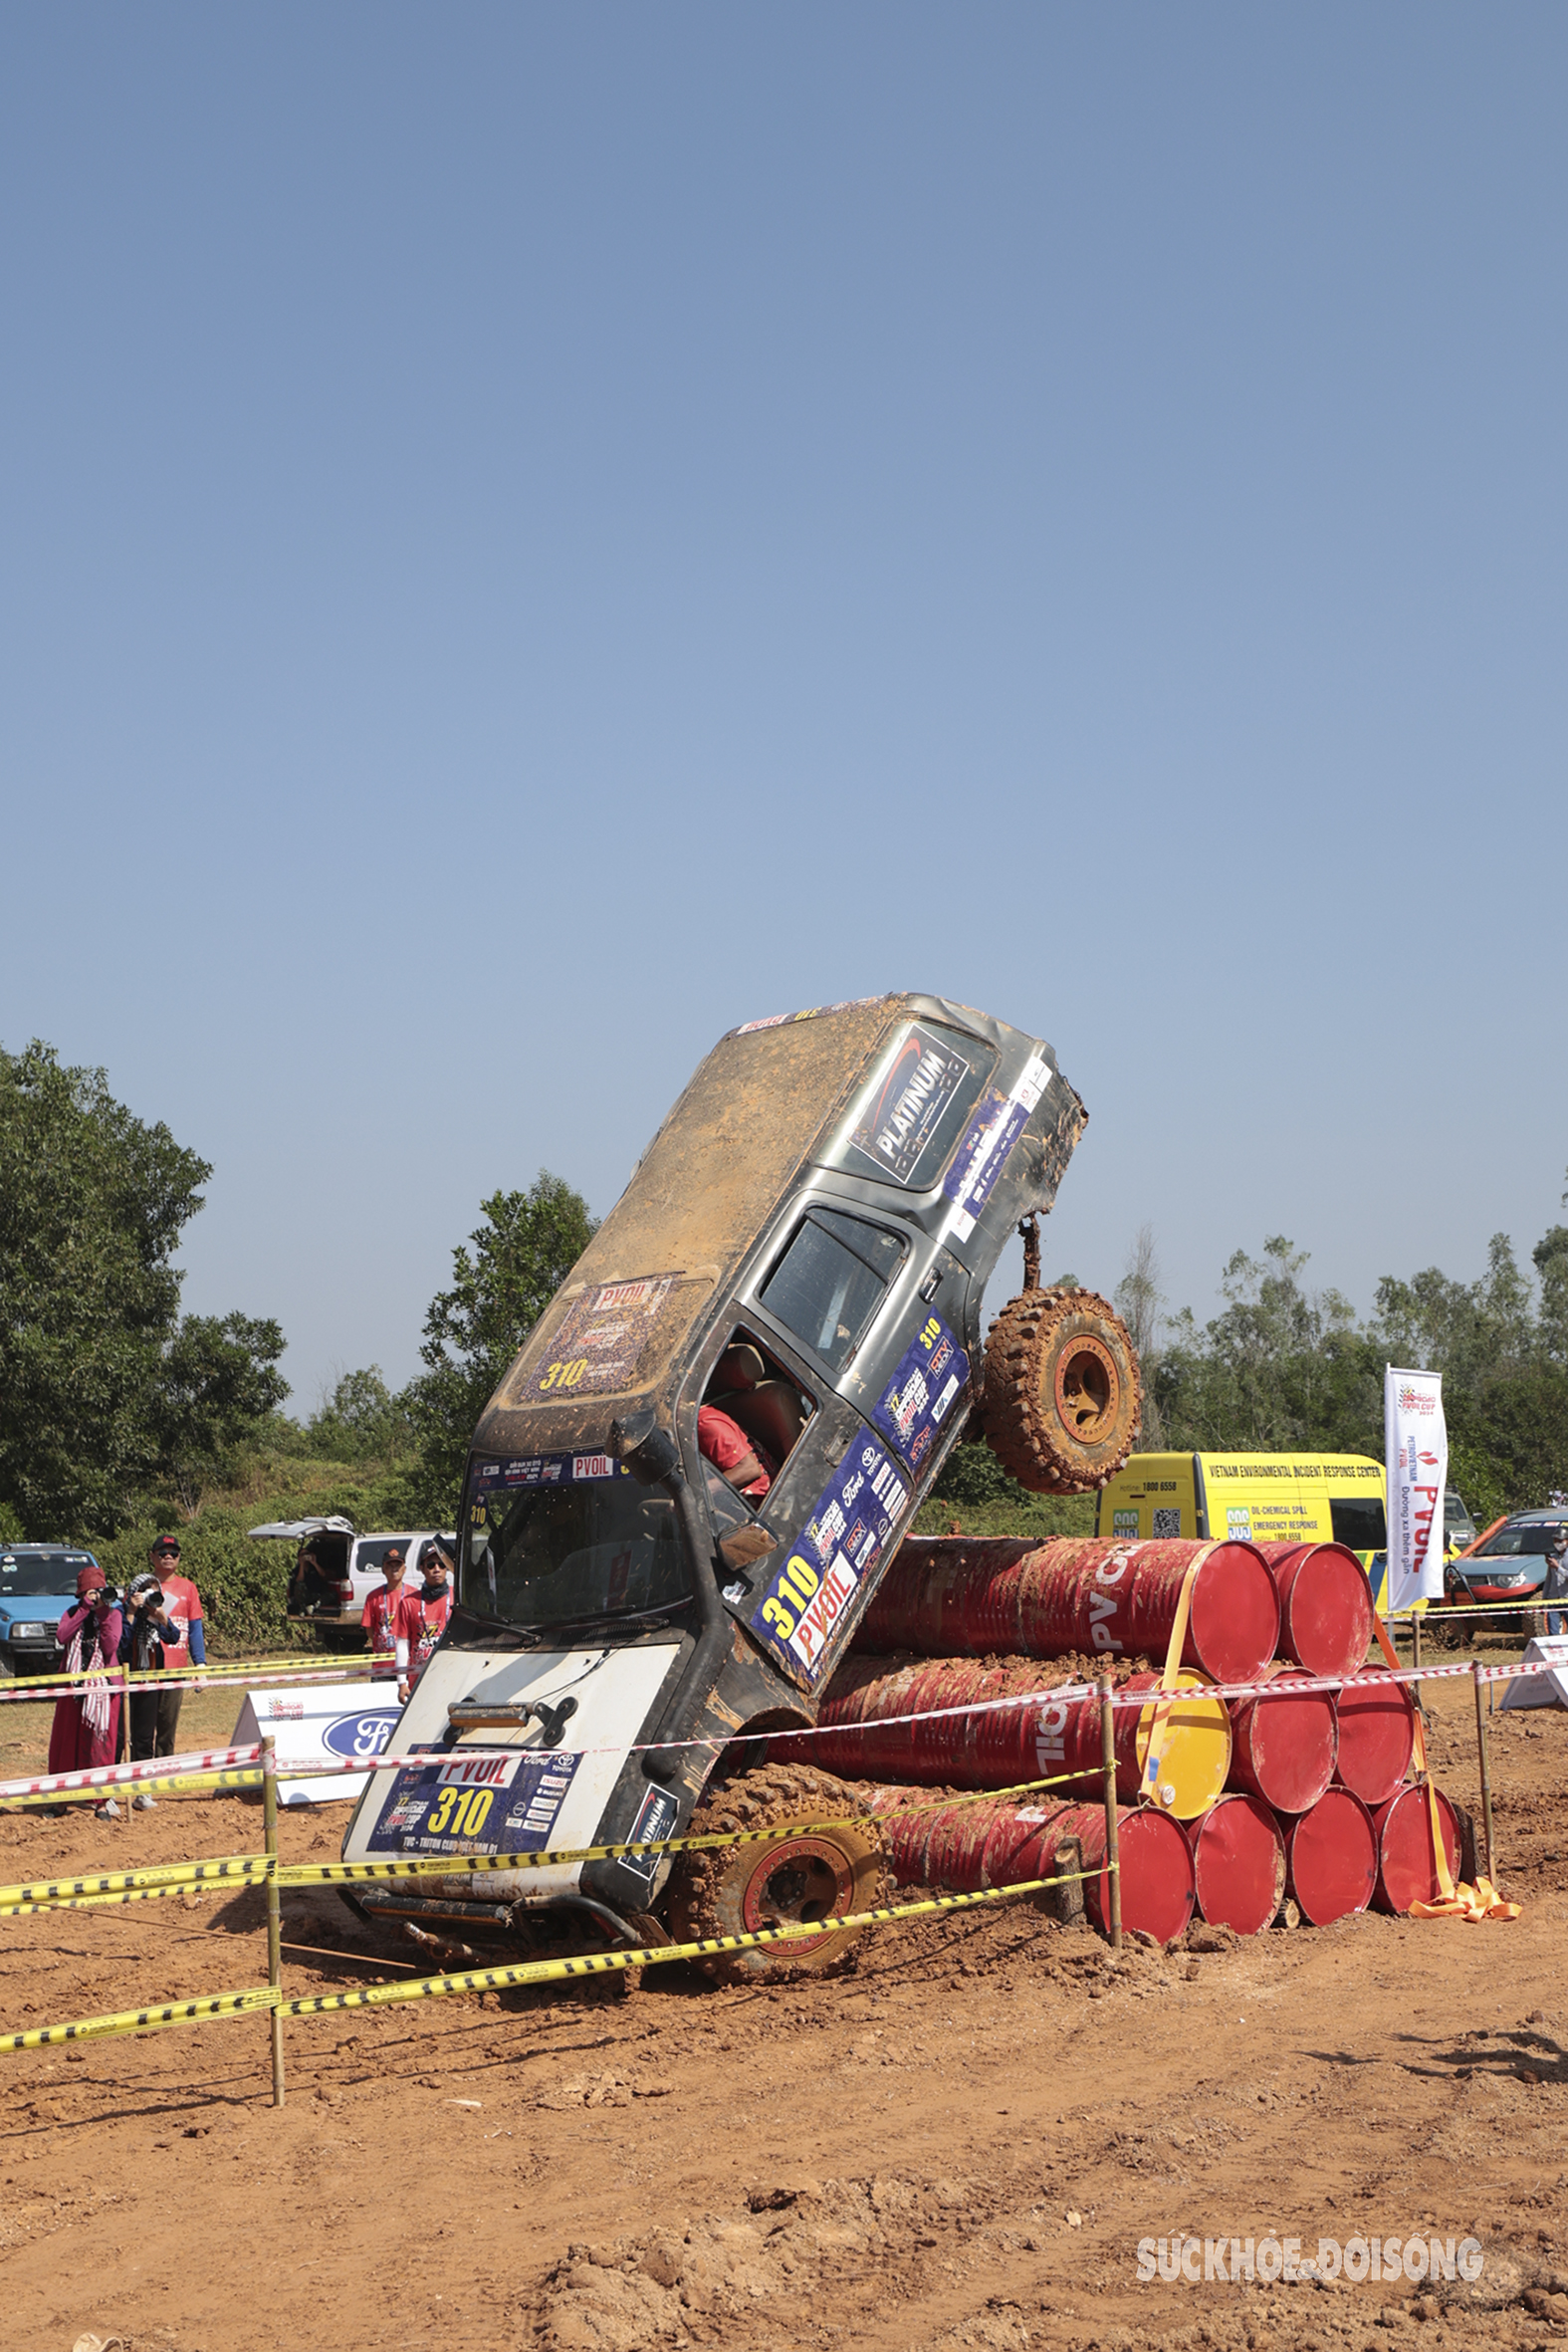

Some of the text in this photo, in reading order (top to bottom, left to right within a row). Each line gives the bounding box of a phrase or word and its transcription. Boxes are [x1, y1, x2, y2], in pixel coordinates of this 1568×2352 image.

[875, 1049, 946, 1161] PLATINUM
[919, 1316, 941, 1350] 310
[539, 1358, 588, 1390] 310
[891, 1394, 900, 1412] 17
[899, 1380, 927, 1432] PVOIL CUP
[576, 1456, 609, 1476] PVOIL
[867, 1453, 882, 1476] TOYOTA
[1399, 1448, 1408, 1469] PVOIL
[1407, 1436, 1418, 1482] PETROVIETNAM
[873, 1466, 889, 1491] ISUZU
[1209, 1466, 1238, 1478] VIETNAM
[1323, 1466, 1356, 1478] RESPONSE
[1357, 1466, 1381, 1478] CENTER
[842, 1471, 864, 1508] Ford
[1143, 1482, 1159, 1492] 1800
[1160, 1482, 1177, 1492] 6558
[471, 1505, 487, 1525] 310
[1251, 1506, 1291, 1515] OIL-CHEMICAL
[1401, 1486, 1410, 1519] Đường
[819, 1511, 844, 1555] PVOIL CUP
[1253, 1521, 1318, 1530] EMERGENCY RESPONSE
[1402, 1520, 1410, 1530] xa
[1413, 1486, 1439, 1573] PVOIL
[762, 1554, 818, 1641] 310
[797, 1569, 851, 1658] PVOIL
[444, 1750, 515, 1784] PVOIL
[543, 1776, 564, 1786] ISUZU
[398, 1796, 410, 1806] 17
[427, 1786, 494, 1836] 310
[386, 1813, 422, 1825] PVOIL CUP
[636, 1796, 667, 1862] PATINUM
[403, 1836, 416, 1847] TVC
[419, 1837, 442, 1849] TRITON
